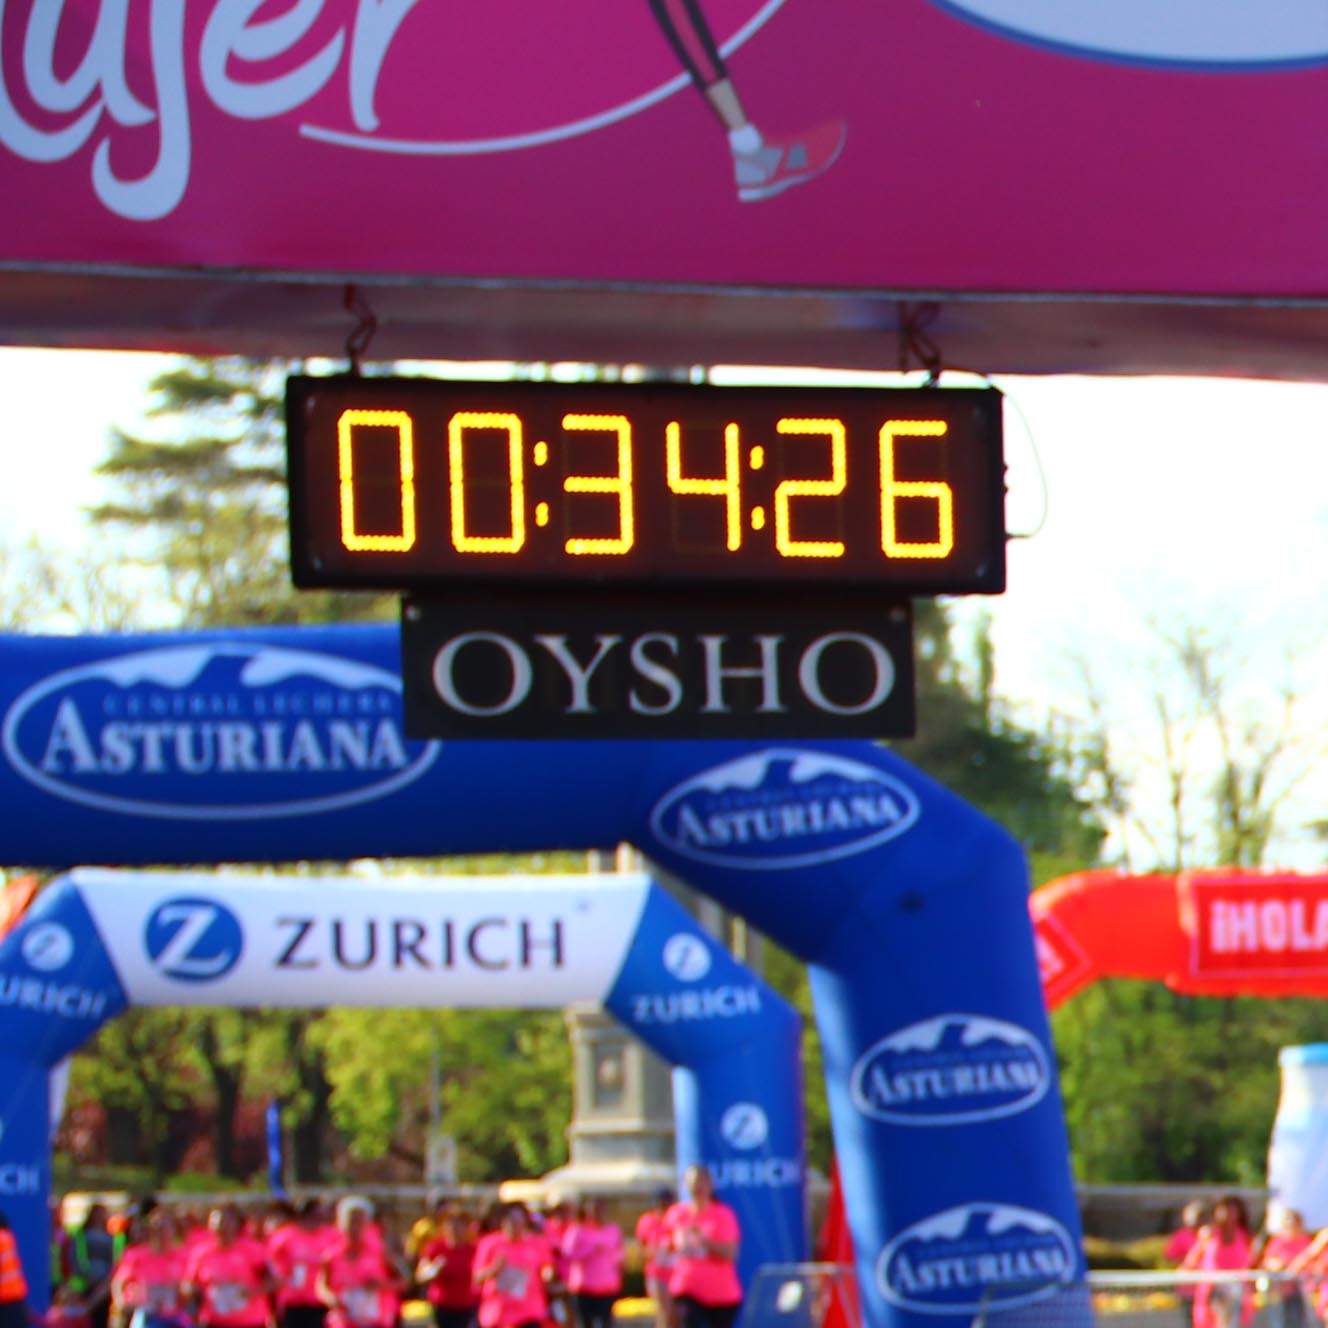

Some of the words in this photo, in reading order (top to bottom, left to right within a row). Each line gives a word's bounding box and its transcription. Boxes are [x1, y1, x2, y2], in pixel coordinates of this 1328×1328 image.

[432, 632, 897, 717] OYSHO
[41, 696, 408, 774] ASTURIANA
[676, 795, 902, 848] ASTURIANA
[273, 915, 566, 972] ZURICH
[632, 985, 762, 1023] ZURICH
